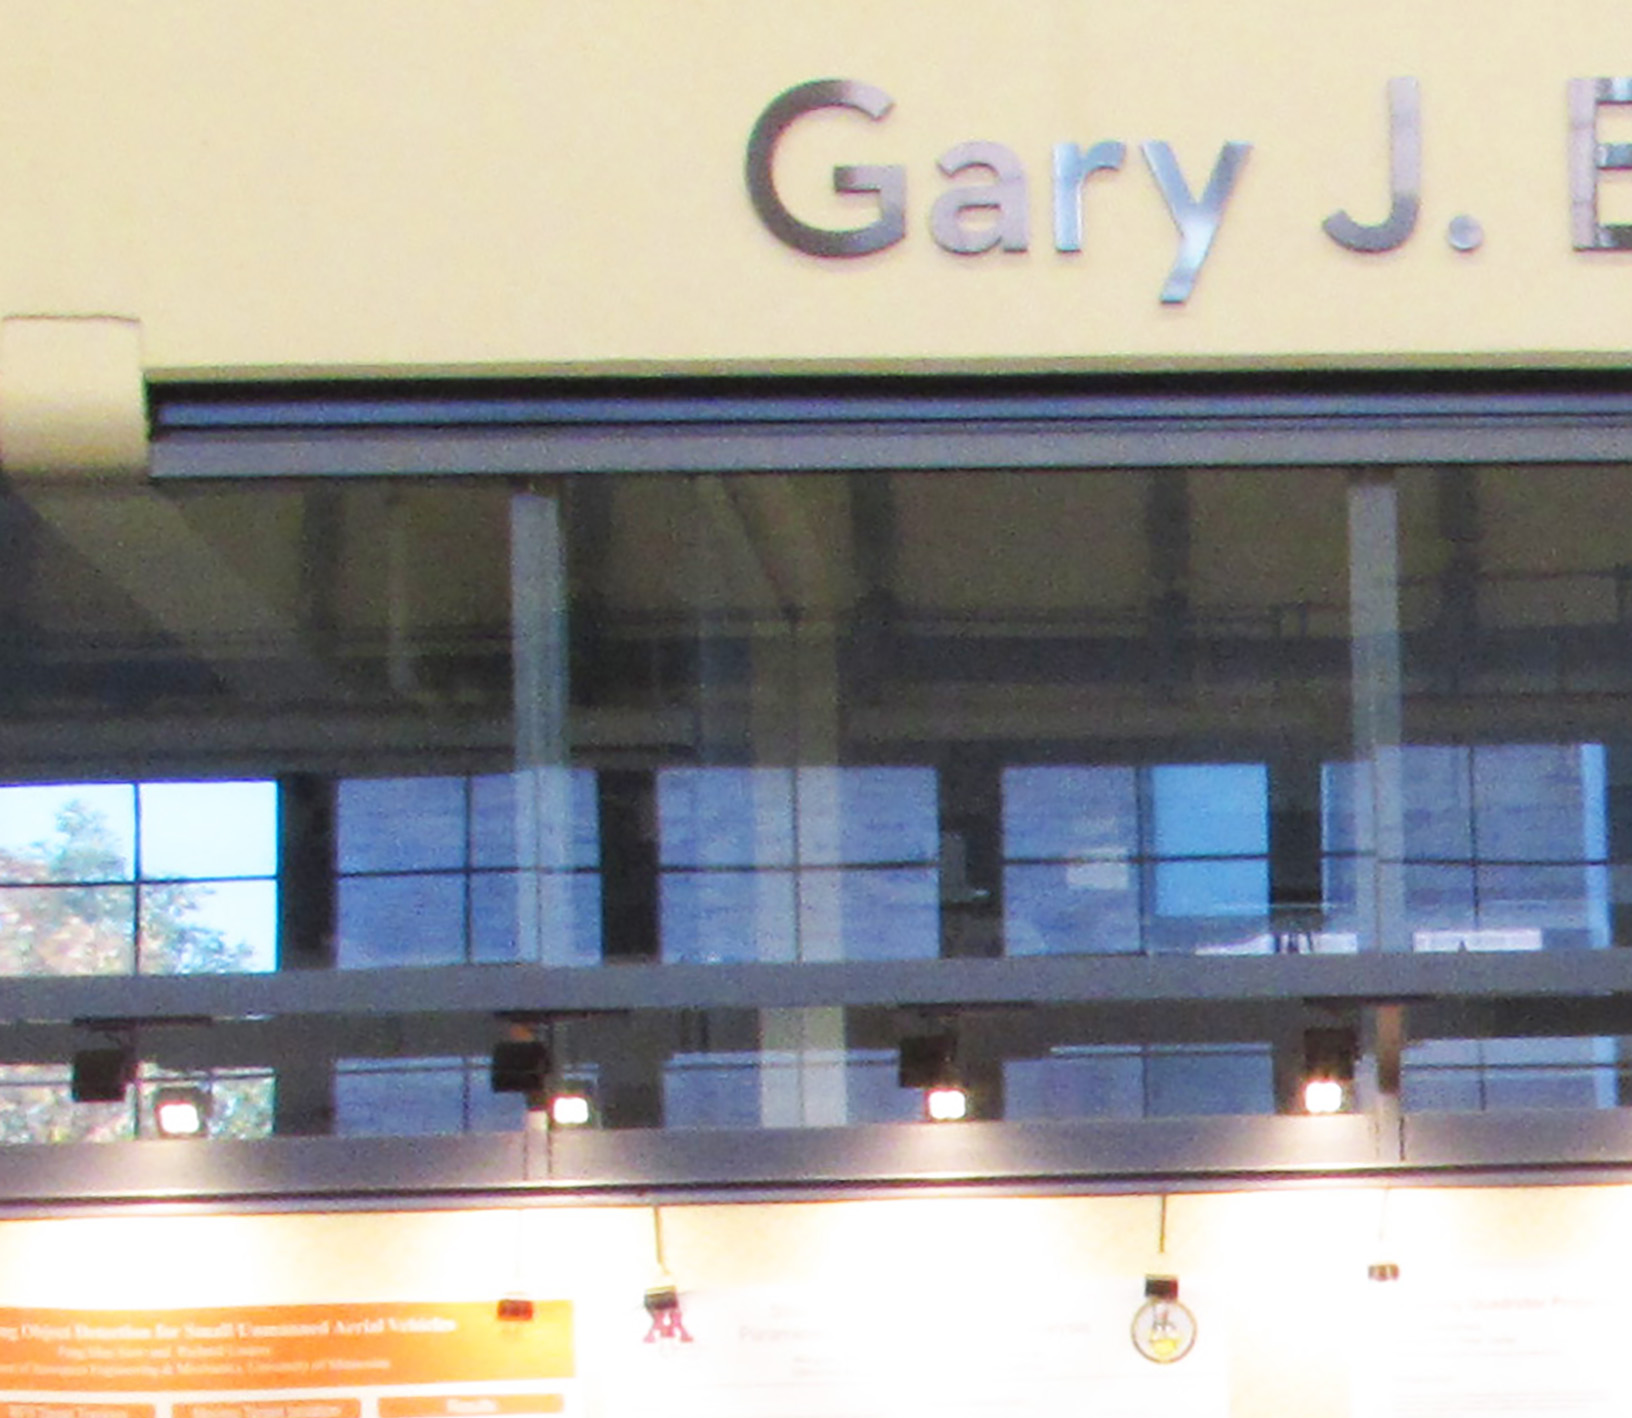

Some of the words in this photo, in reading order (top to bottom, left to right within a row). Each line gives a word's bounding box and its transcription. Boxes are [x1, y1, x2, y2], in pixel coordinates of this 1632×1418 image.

[745, 77, 1252, 307] Gary
[1321, 77, 1485, 256] J.
[155, 1322, 180, 1339] for
[183, 1321, 236, 1338] Small
[335, 1318, 384, 1336] Aerial
